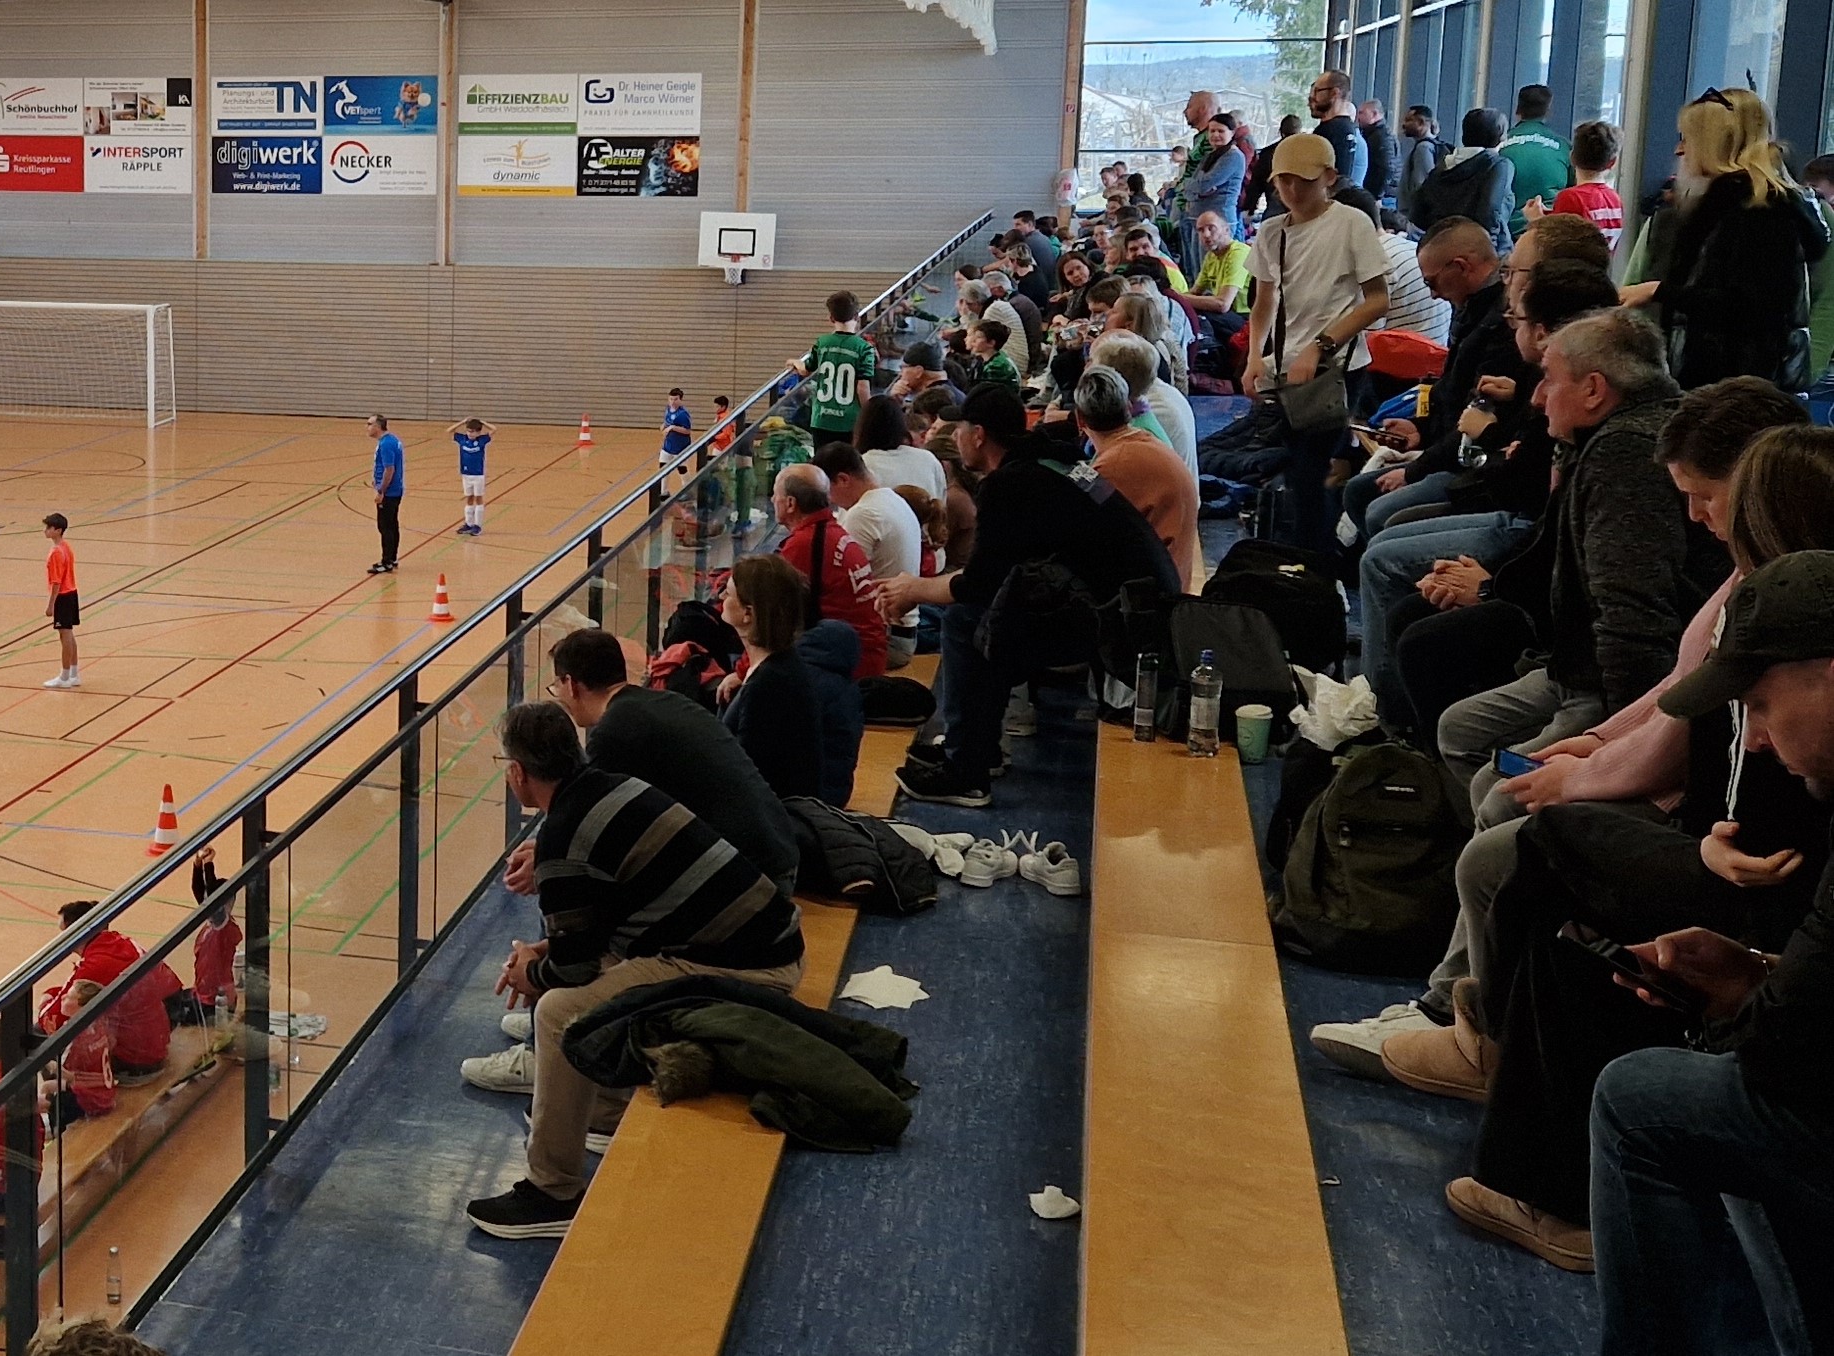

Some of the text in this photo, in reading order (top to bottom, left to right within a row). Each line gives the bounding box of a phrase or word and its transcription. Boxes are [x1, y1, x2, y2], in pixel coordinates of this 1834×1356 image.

[619, 81, 695, 93] Dr. Heiner Geigle
[478, 93, 569, 104] EFFIZIENZBAU
[624, 93, 694, 103] Marco Wörner
[6, 104, 78, 113] Schönbuchhof
[103, 146, 185, 158] INTERSPORT
[613, 148, 646, 157] ALTER
[13, 154, 72, 164] Kreissparkasse
[340, 155, 392, 168] NECKER
[598, 157, 644, 166] ENERGIE
[13, 164, 56, 175] Reutlingen
[122, 160, 163, 171] RÄPPLE
[493, 170, 541, 182] dynamic
[233, 181, 301, 193] www.digiwerk.de
[817, 360, 856, 406] 30
